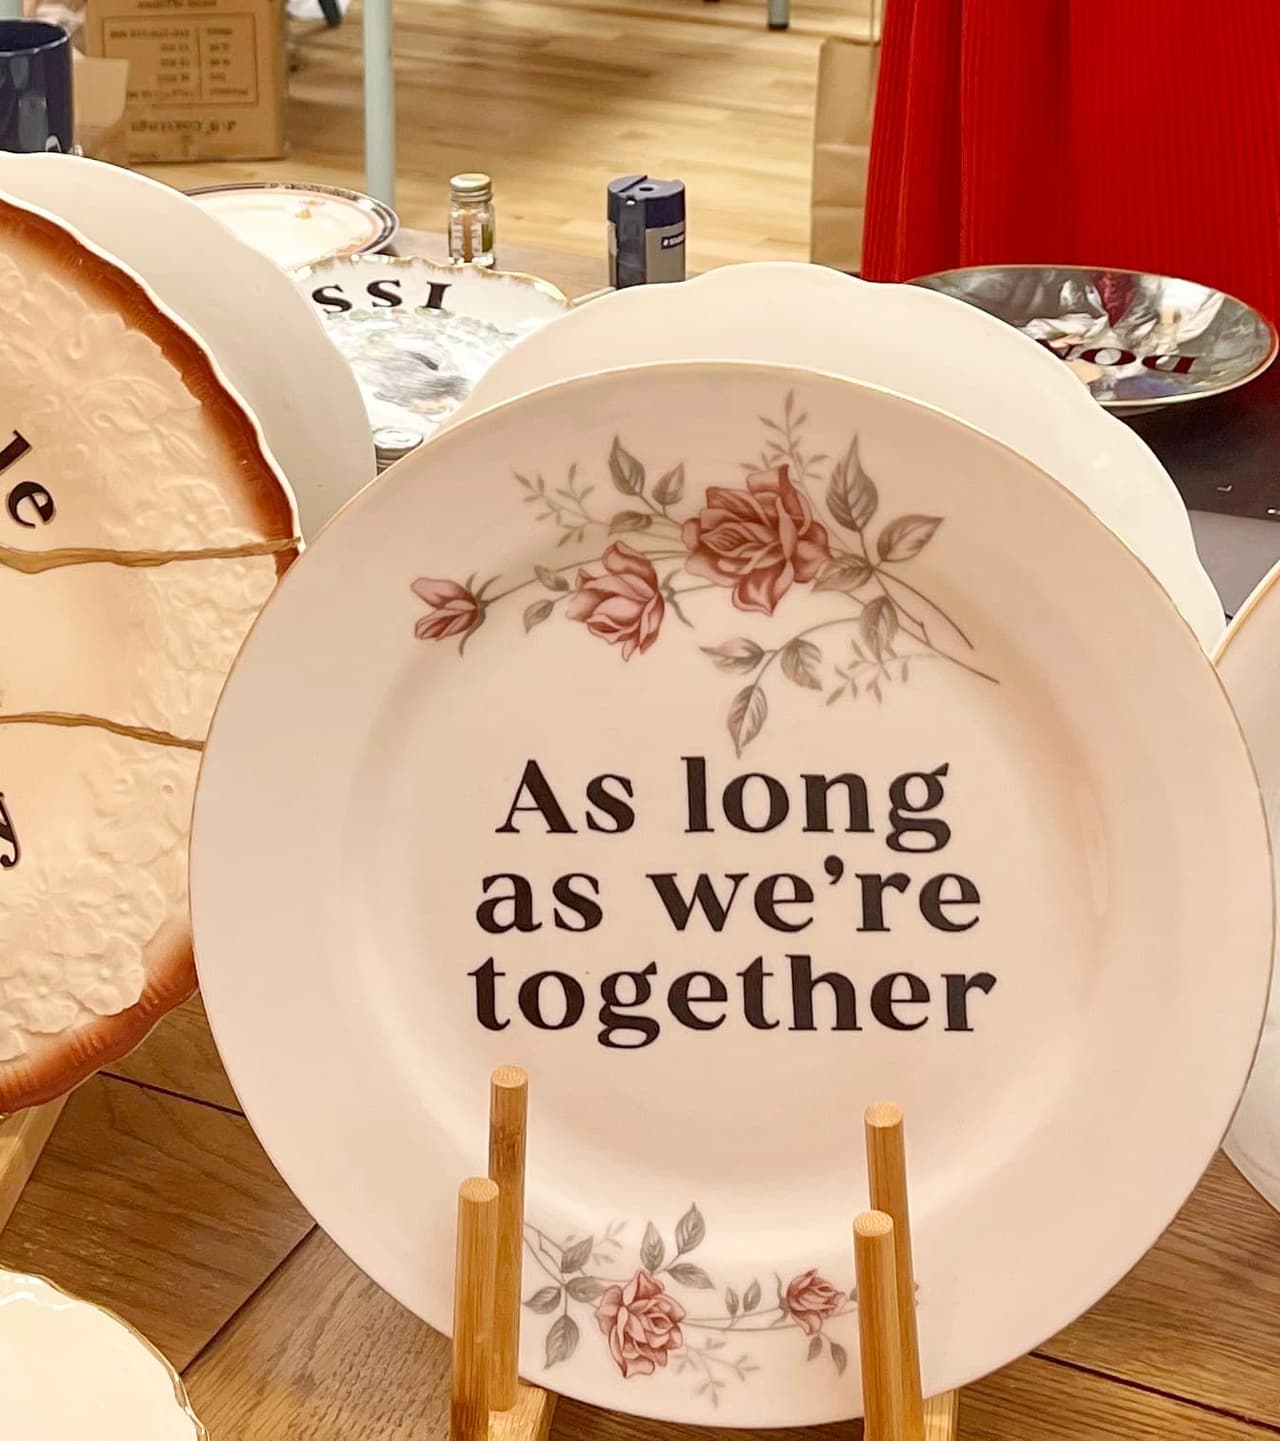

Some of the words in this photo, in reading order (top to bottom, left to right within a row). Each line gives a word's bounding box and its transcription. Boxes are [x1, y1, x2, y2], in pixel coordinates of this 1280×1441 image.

[494, 758, 636, 834] As
[680, 756, 952, 853] long
[475, 872, 604, 934] as
[467, 954, 998, 1049] together
